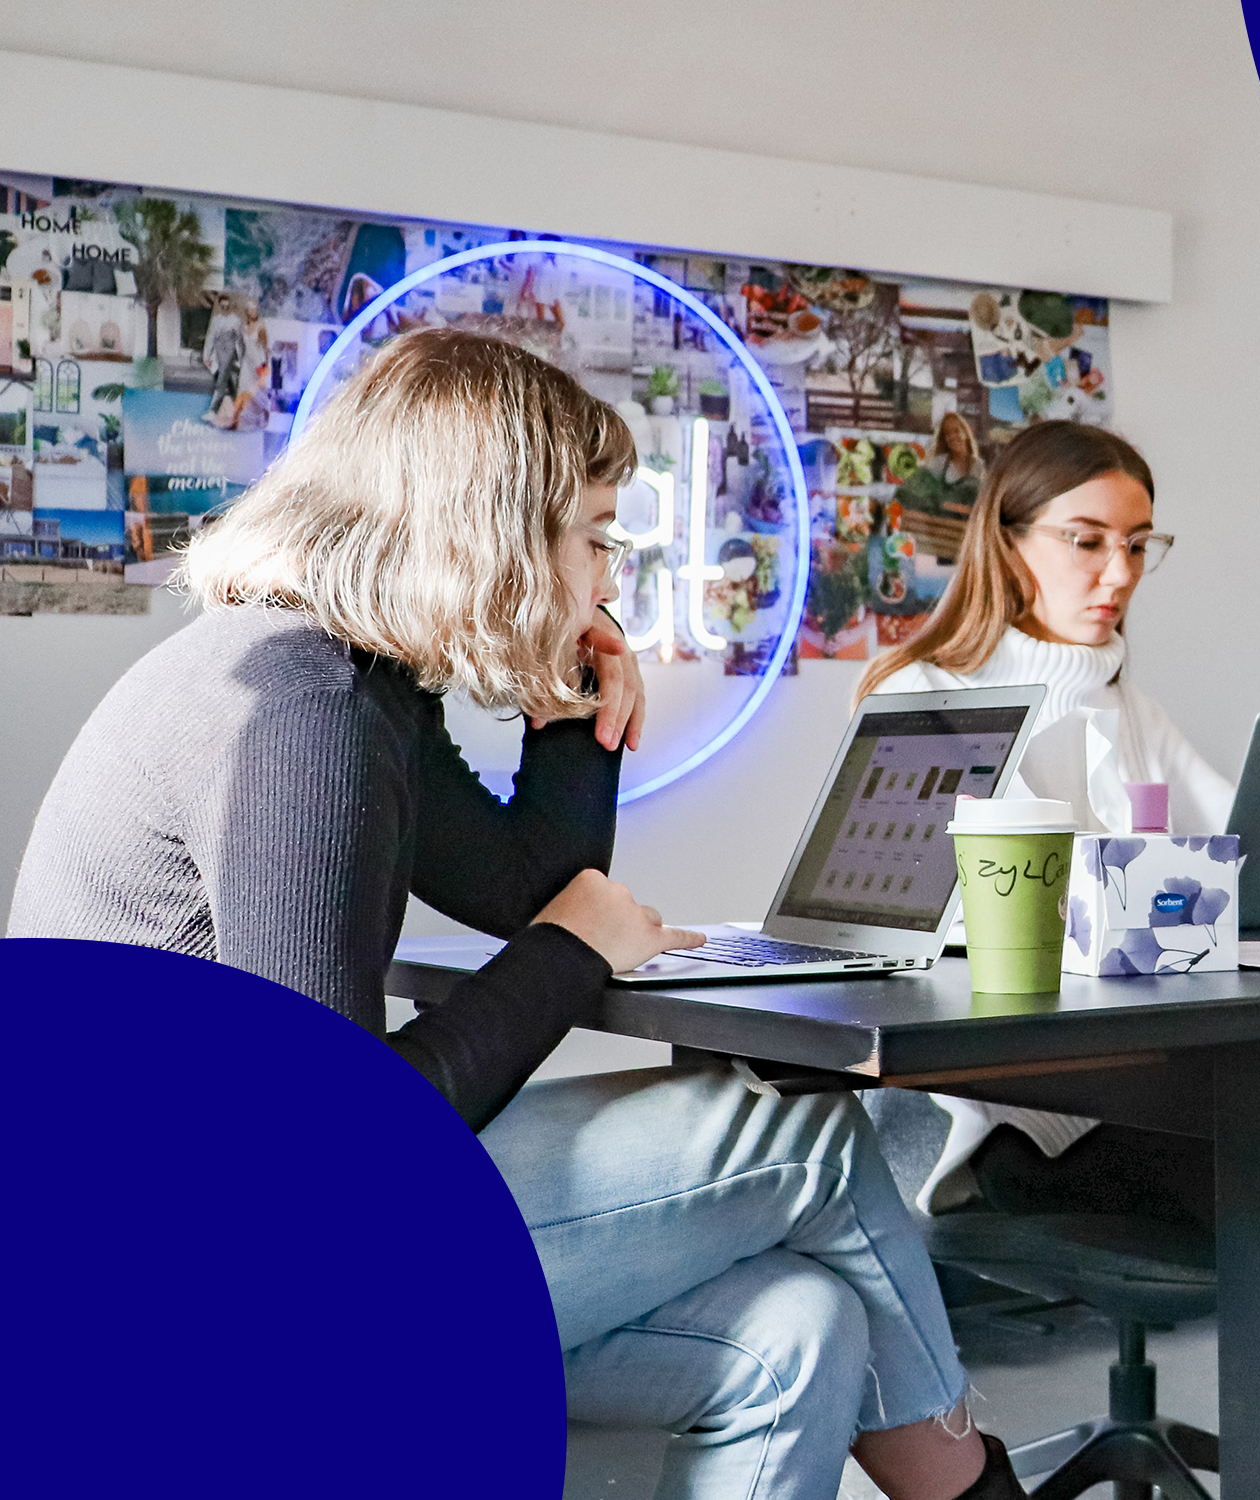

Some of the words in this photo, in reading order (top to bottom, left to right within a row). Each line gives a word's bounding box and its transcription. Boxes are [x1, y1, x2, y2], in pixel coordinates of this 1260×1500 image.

[21, 212, 81, 235] HOME
[72, 243, 131, 263] HOME
[167, 475, 228, 497] money
[1156, 897, 1185, 907] Sorbent
